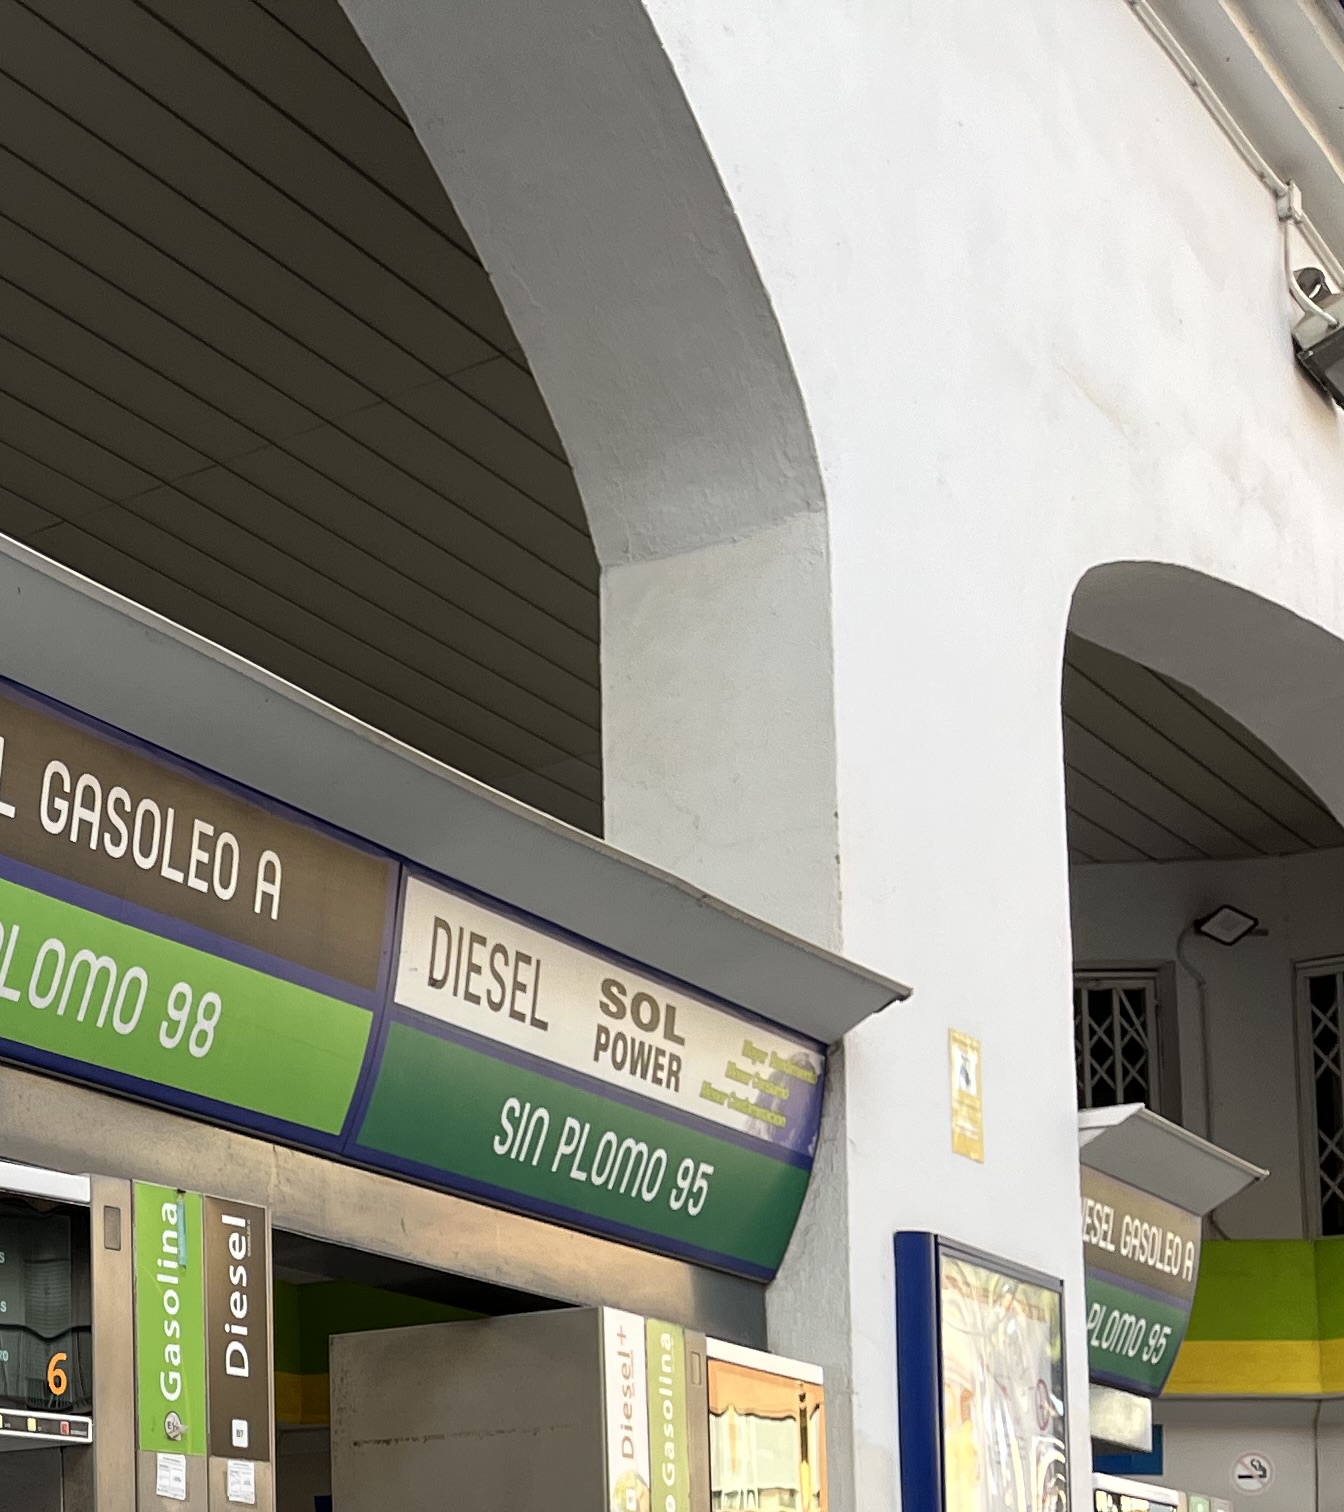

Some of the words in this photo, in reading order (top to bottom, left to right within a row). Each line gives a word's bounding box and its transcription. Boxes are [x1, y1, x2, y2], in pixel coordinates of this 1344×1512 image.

[39, 760, 239, 901] GASOLEO
[254, 850, 282, 920] A
[159, 981, 223, 1058] 98
[427, 915, 548, 1032] DIESEL
[598, 977, 686, 1046] SOL
[593, 1023, 683, 1093] POWER
[493, 1097, 551, 1166] SIN
[551, 1116, 669, 1202] PLOMO
[669, 1157, 714, 1216] 95
[1082, 1197, 1115, 1252] ESEL
[1120, 1214, 1182, 1276] GASOLEO
[1182, 1240, 1195, 1282] A
[157, 1202, 182, 1401] Gasolina
[221, 1214, 250, 1378] Diesel
[1142, 1323, 1172, 1365] 95
[47, 1352, 68, 1396] 6
[659, 1333, 676, 1486] Gasolina
